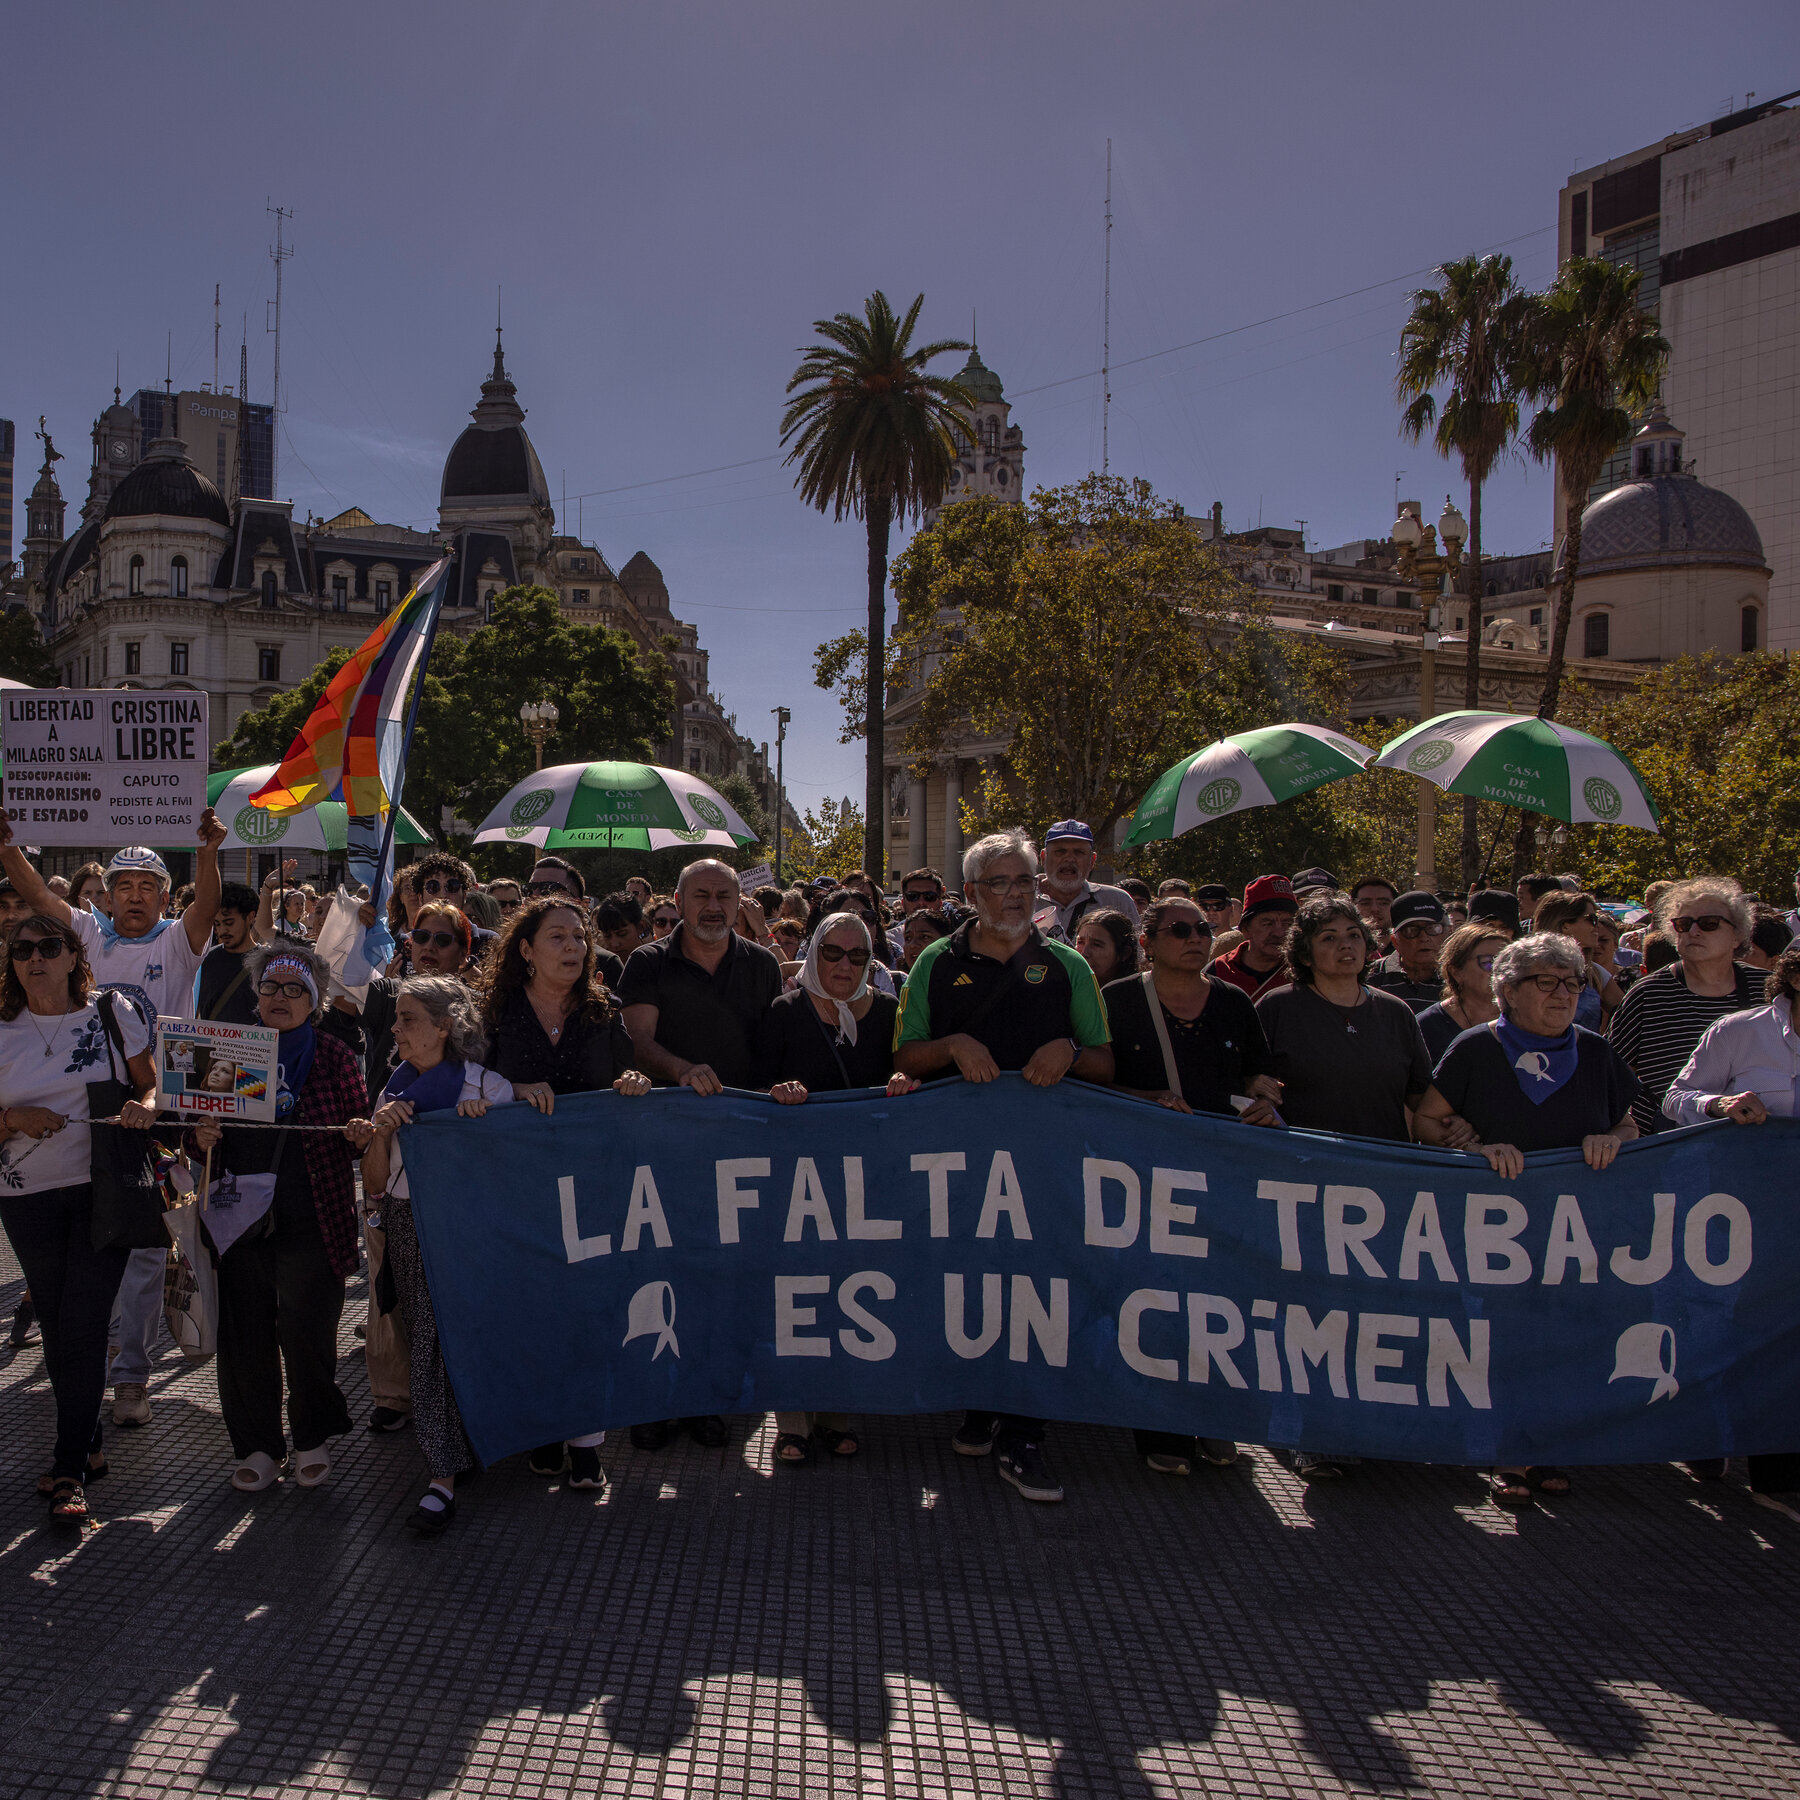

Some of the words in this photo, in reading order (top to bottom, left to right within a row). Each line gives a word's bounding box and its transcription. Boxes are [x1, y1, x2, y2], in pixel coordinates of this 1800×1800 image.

[187, 402, 237, 421] Pampa
[9, 700, 94, 721] LIBERTAD
[111, 699, 202, 724] CRISTINA
[48, 724, 59, 741] A
[116, 727, 195, 761] LIBRE
[6, 747, 65, 763] MILAGRO
[70, 747, 104, 762] SALA
[1280, 751, 1310, 765] CASA
[8, 769, 92, 781] DESOCUPACIÓN:
[1295, 762, 1313, 772] DE
[1503, 763, 1541, 779] CASA
[123, 775, 180, 787] CAPUTO
[1289, 767, 1338, 787] MONEDA
[1508, 777, 1528, 790] DE
[8, 787, 102, 801] TERRORISMO
[109, 797, 153, 807] PEDISTE
[156, 797, 169, 806] AL
[172, 797, 192, 806] FMI
[605, 790, 643, 798] CASA
[1206, 785, 1233, 808] ATE
[1482, 785, 1546, 808] MONEDA
[1591, 786, 1615, 812] ATE
[520, 795, 546, 818] ATE
[616, 802, 636, 810] DE
[8, 809, 27, 822] DE
[33, 808, 89, 822] ESTADO
[111, 815, 134, 825] VOS
[137, 815, 151, 825] LO
[155, 815, 192, 825] PAGAS
[596, 813, 660, 823] MONEDA
[246, 811, 280, 837] ATE
[261, 821, 287, 844] MONEDA
[740, 865, 766, 881] Justicia
[267, 964, 303, 977] LIBRE
[222, 1041, 245, 1050] PATRIA
[245, 1045, 271, 1054] GRANDE
[558, 1165, 673, 1264] LA
[716, 1150, 1034, 1244] FALTA
[1083, 1158, 1209, 1259] DE
[1257, 1180, 1753, 1286] TRABAJO
[775, 1271, 897, 1362] ES
[944, 1273, 1070, 1368] UN
